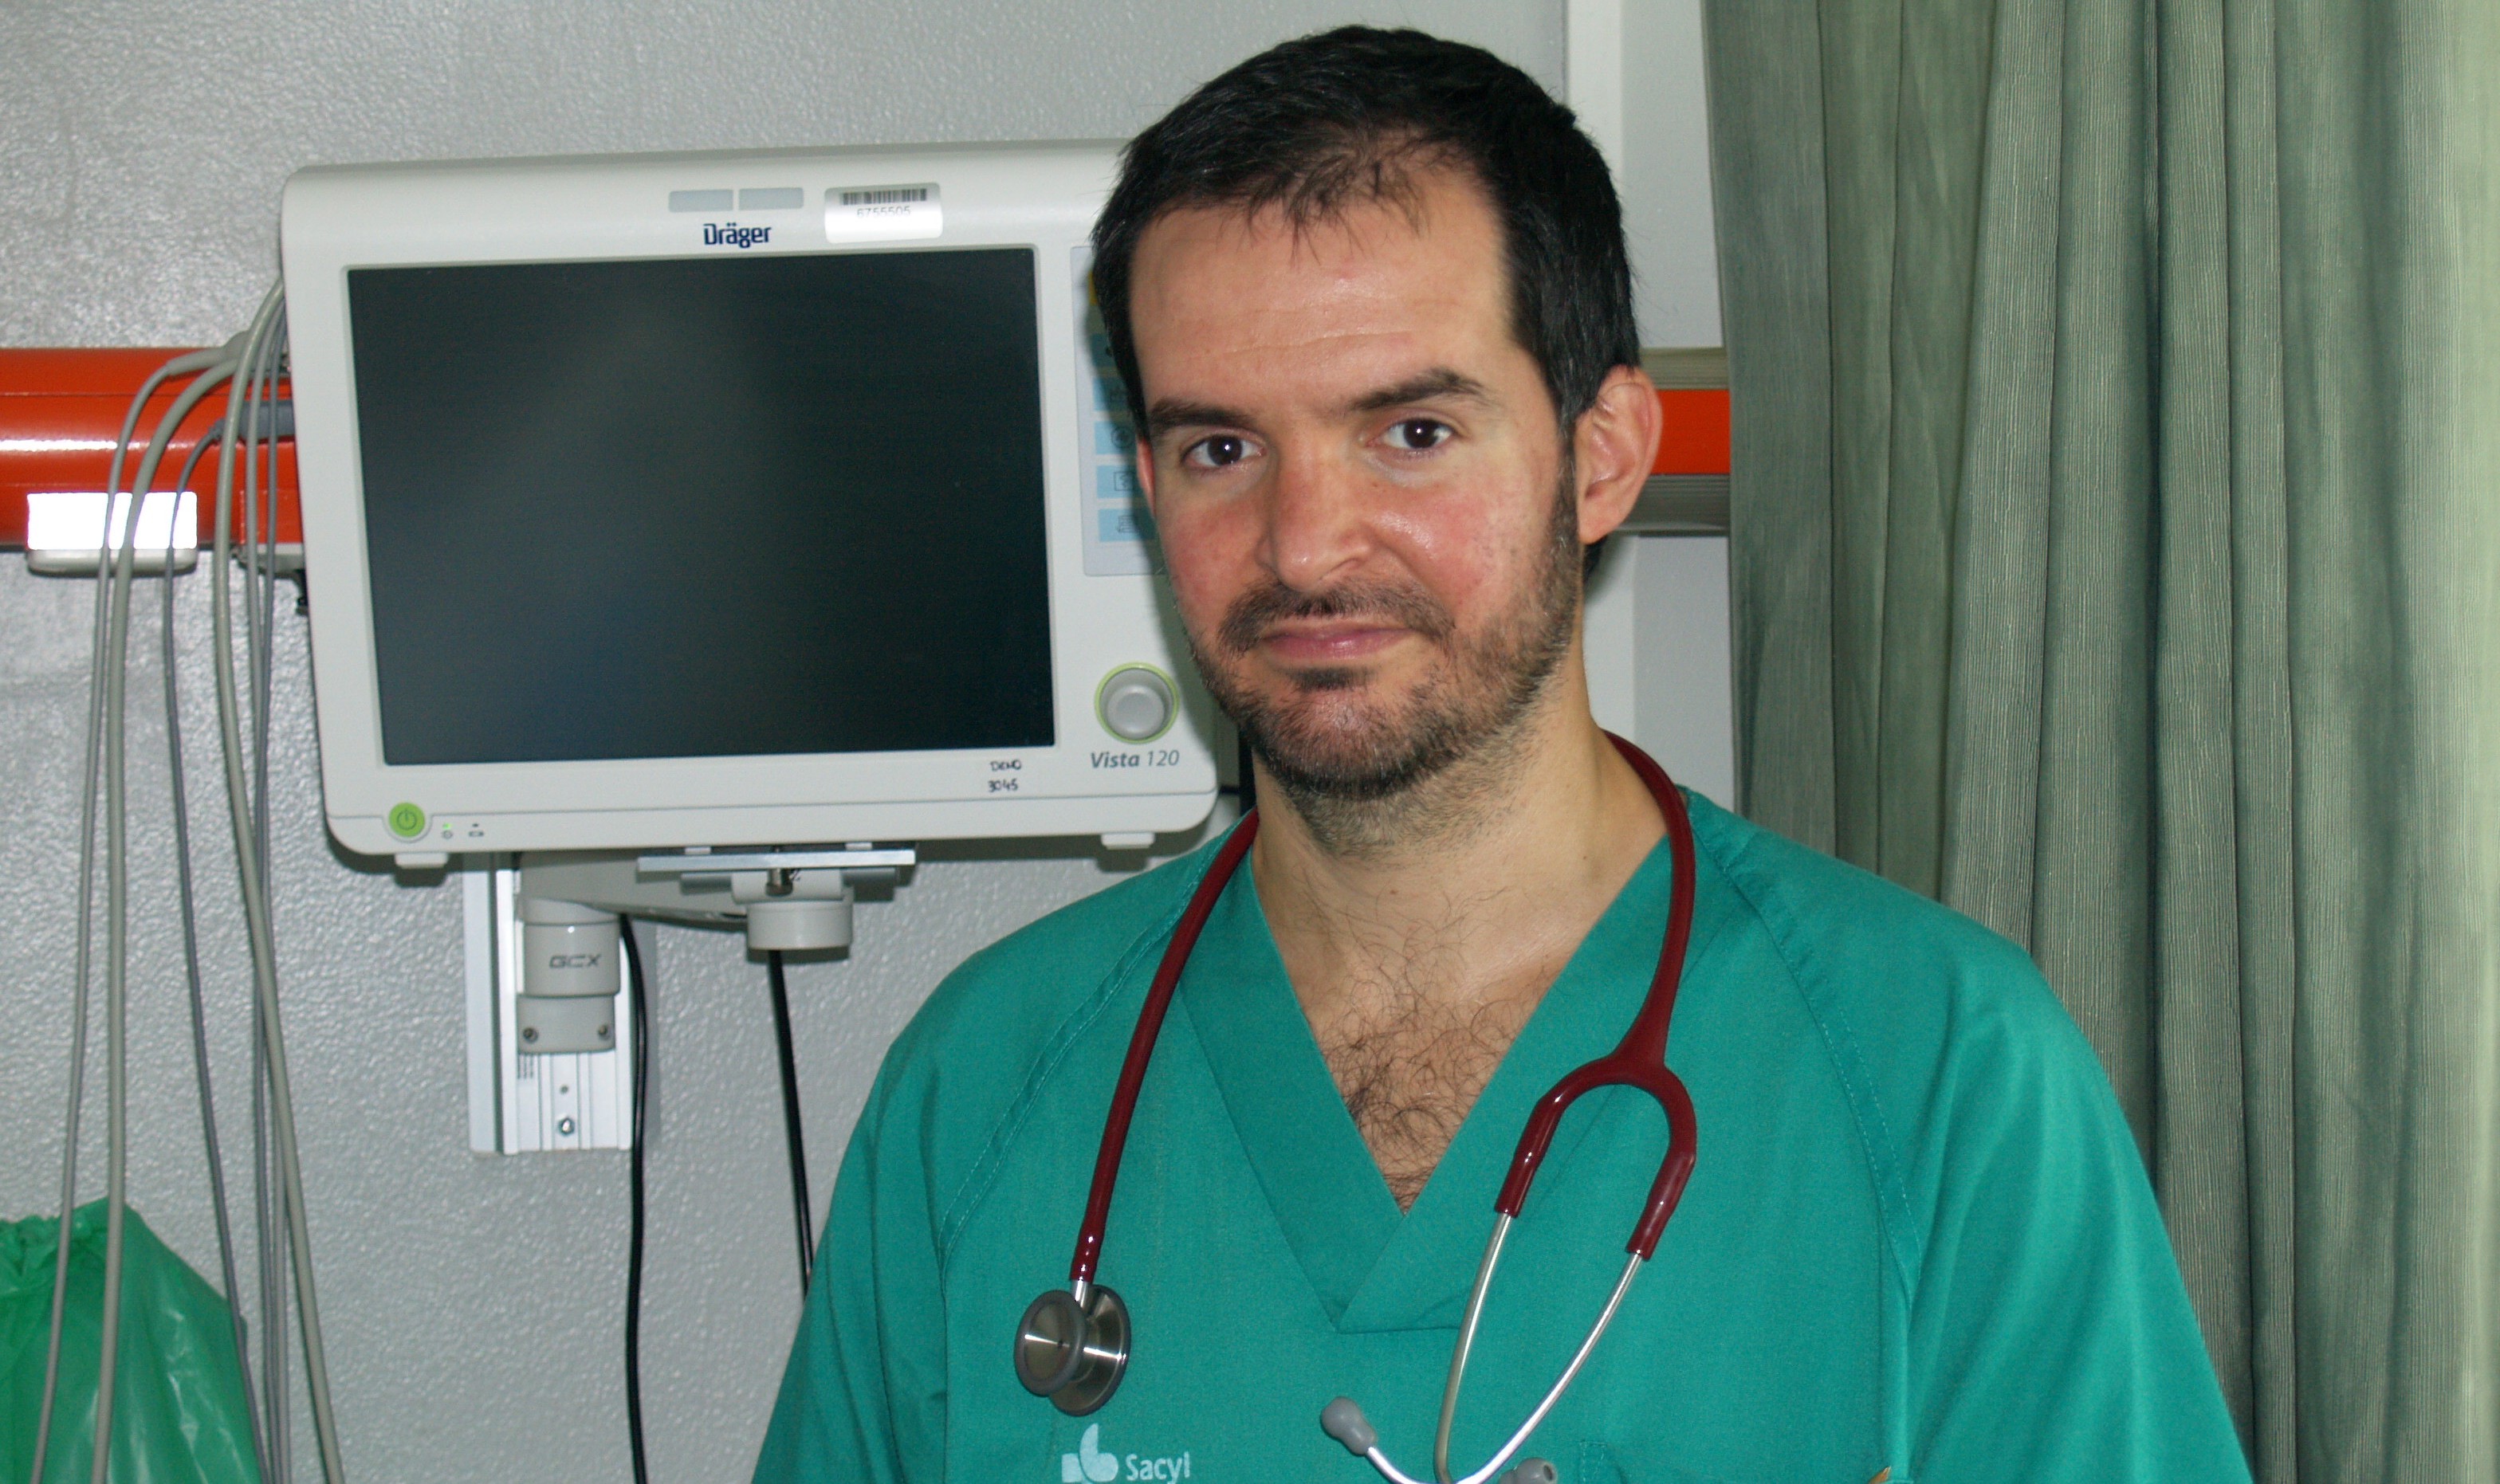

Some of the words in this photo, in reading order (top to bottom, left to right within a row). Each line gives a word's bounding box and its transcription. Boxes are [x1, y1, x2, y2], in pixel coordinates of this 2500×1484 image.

[703, 222, 772, 249] Dräger
[1091, 752, 1140, 768] Vista
[1146, 750, 1180, 766] 120
[988, 778, 1019, 793] 3045
[549, 954, 602, 969] GCX
[1125, 1451, 1190, 1484] Sacyl
